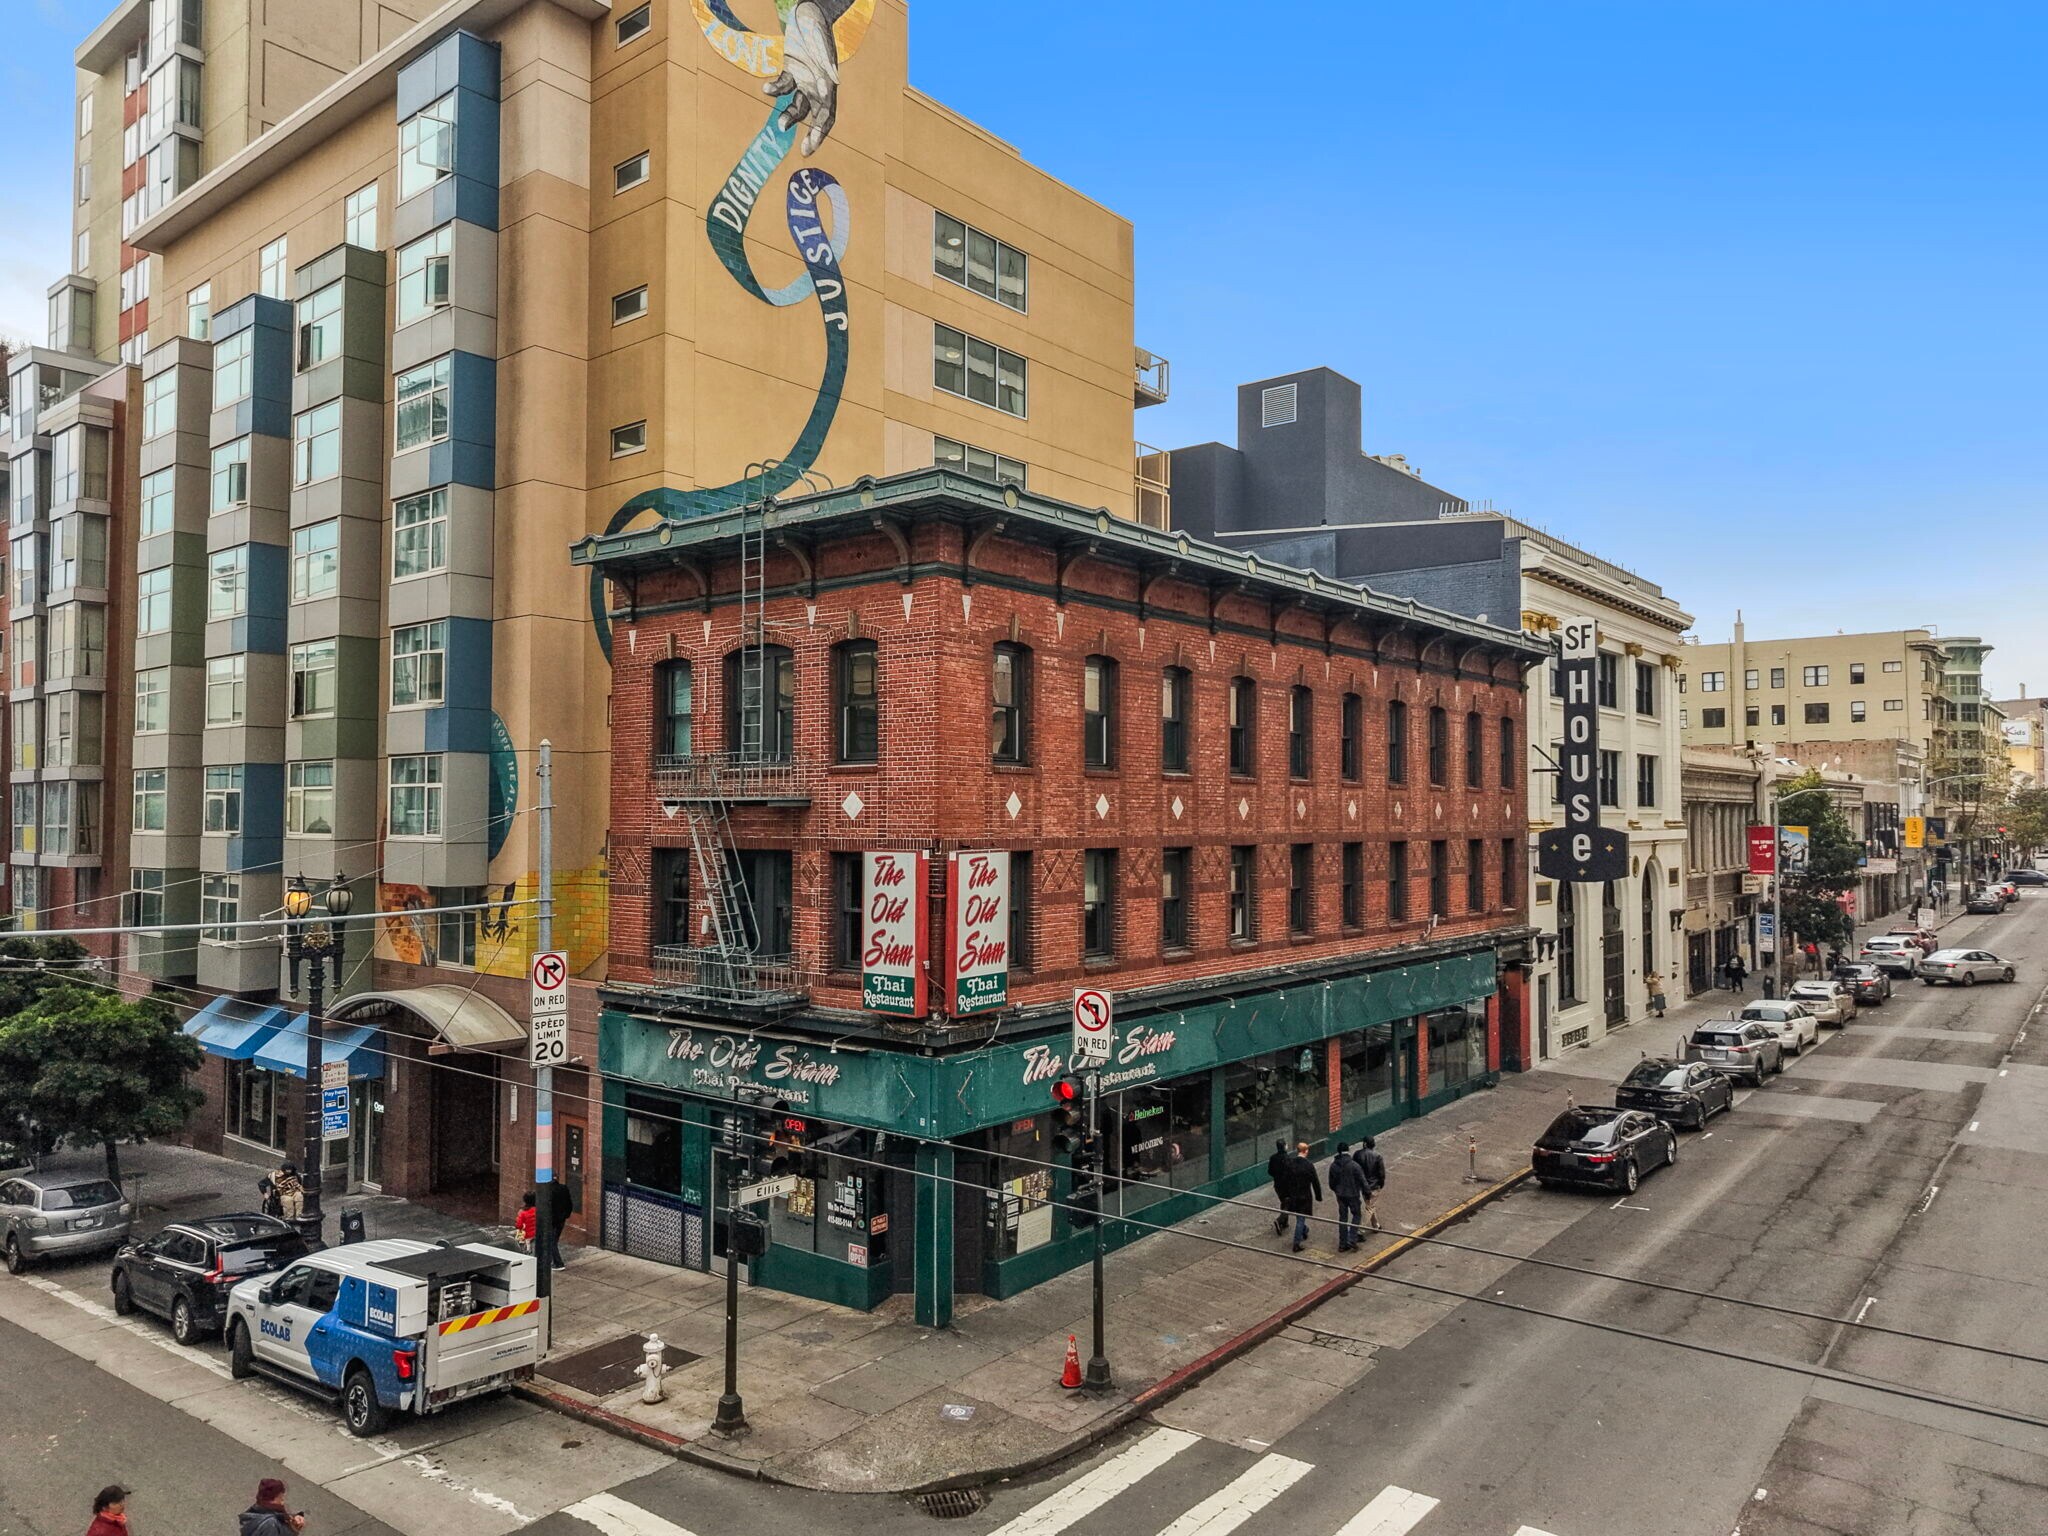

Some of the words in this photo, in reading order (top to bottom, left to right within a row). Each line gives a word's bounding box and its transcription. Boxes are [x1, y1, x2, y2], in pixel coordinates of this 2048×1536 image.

[704, 17, 778, 76] LOVE
[712, 125, 785, 234] DIGNITY
[788, 169, 848, 330] JUSTICE
[1565, 624, 1592, 650] SF
[2005, 726, 2026, 736] Kids
[874, 855, 905, 887] The
[968, 856, 998, 890] The
[871, 893, 908, 925] Old
[965, 894, 1001, 927] Old
[864, 929, 914, 967] Siam
[958, 930, 1006, 973] Siam
[872, 975, 906, 993] Thai
[967, 975, 998, 995] Thai
[534, 996, 545, 1007] ON
[548, 994, 565, 1005] RED
[864, 989, 914, 1009] Restaurant
[958, 990, 1006, 1012] Restaurant
[534, 1018, 565, 1030] SPEED
[537, 1029, 562, 1040] LIMIT
[535, 1040, 564, 1061] 20
[1077, 1036, 1088, 1047] ON
[1091, 1038, 1107, 1049] RED
[667, 1027, 704, 1061] The
[709, 1035, 761, 1071] Old
[765, 1046, 840, 1086] Siam
[1023, 1044, 1063, 1086] The
[1118, 1025, 1176, 1065] Siam
[693, 1068, 724, 1087] Thai
[1134, 1106, 1164, 1120] Heineken
[785, 1119, 805, 1132] OPEN
[1014, 1119, 1034, 1131] OPEN
[757, 1184, 780, 1197] Ellis
[369, 1306, 394, 1324] ECOLAB
[260, 1318, 291, 1342] ECOLAB
